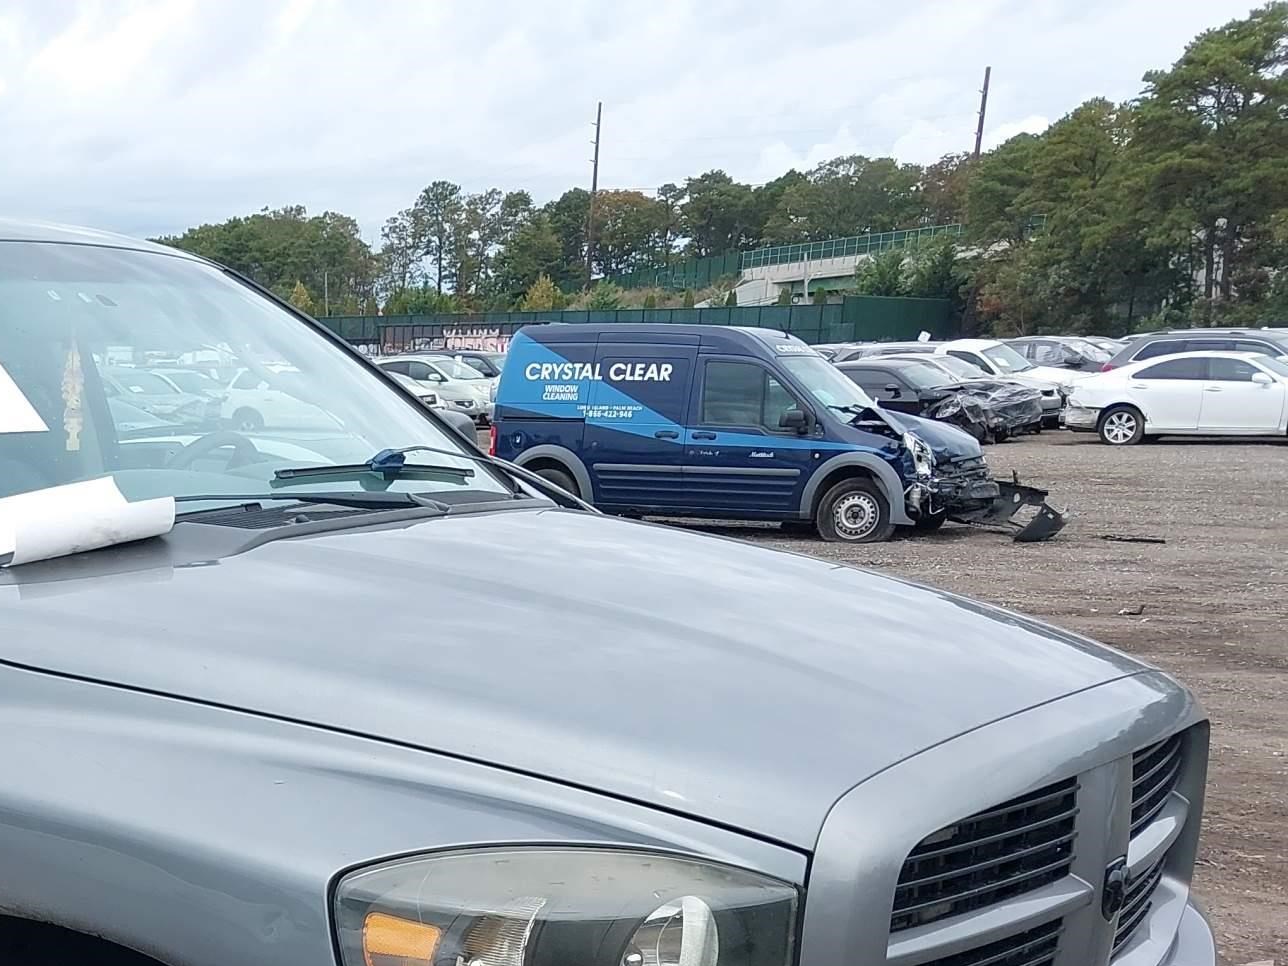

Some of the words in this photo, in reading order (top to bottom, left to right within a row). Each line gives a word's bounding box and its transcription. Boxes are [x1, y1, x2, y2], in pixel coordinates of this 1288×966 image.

[525, 362, 603, 381] CRYSTAL
[609, 362, 673, 381] CLEAR
[544, 384, 579, 393] WINDOW
[542, 392, 579, 401] CLEANING
